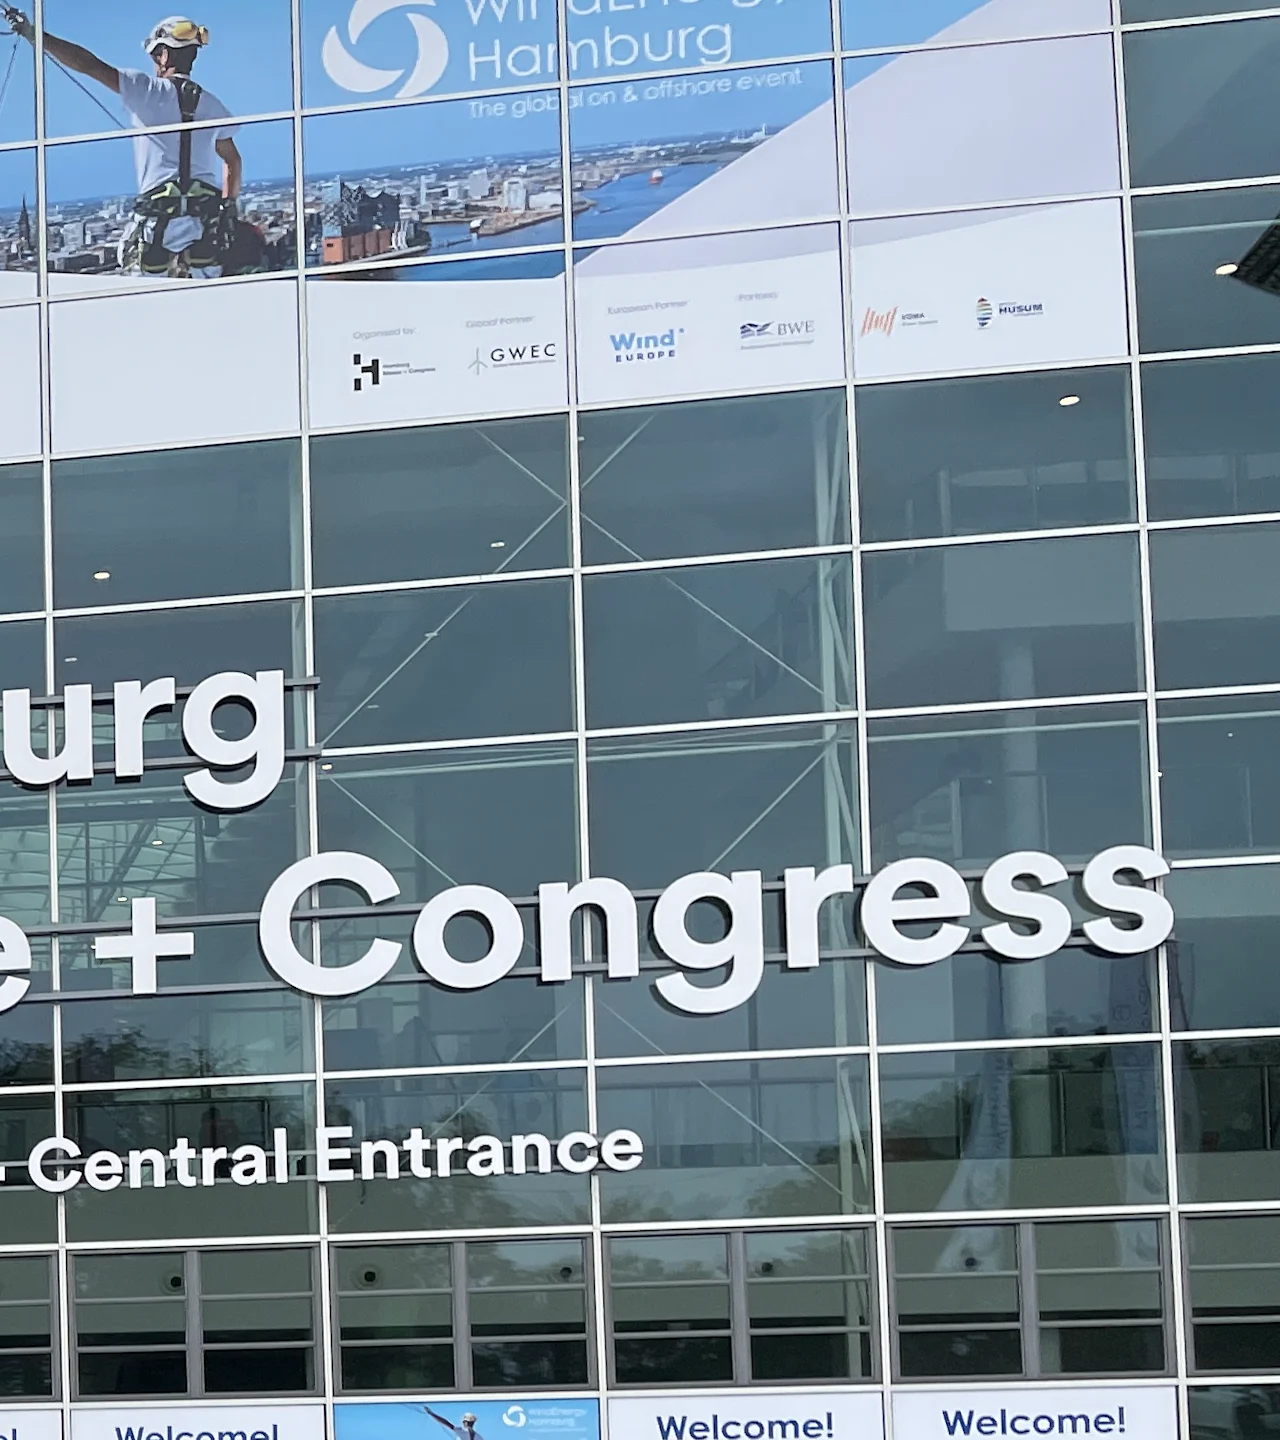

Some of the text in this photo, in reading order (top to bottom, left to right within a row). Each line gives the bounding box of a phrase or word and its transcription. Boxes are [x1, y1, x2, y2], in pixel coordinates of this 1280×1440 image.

[468, 22, 733, 81] Hamburg
[469, 100, 507, 120] The
[589, 89, 617, 108] on
[623, 84, 640, 104] &
[644, 76, 733, 103] offshore
[736, 66, 805, 92] event
[609, 328, 676, 352] Wind
[777, 320, 816, 337] BWE
[490, 343, 557, 363] GWEC
[615, 349, 677, 363] EUROPE
[94, 897, 194, 994] +
[259, 845, 1175, 1015] Congress
[28, 1127, 288, 1194] Central
[317, 1125, 643, 1183] Entrance
[943, 1406, 1127, 1438] Welcome!
